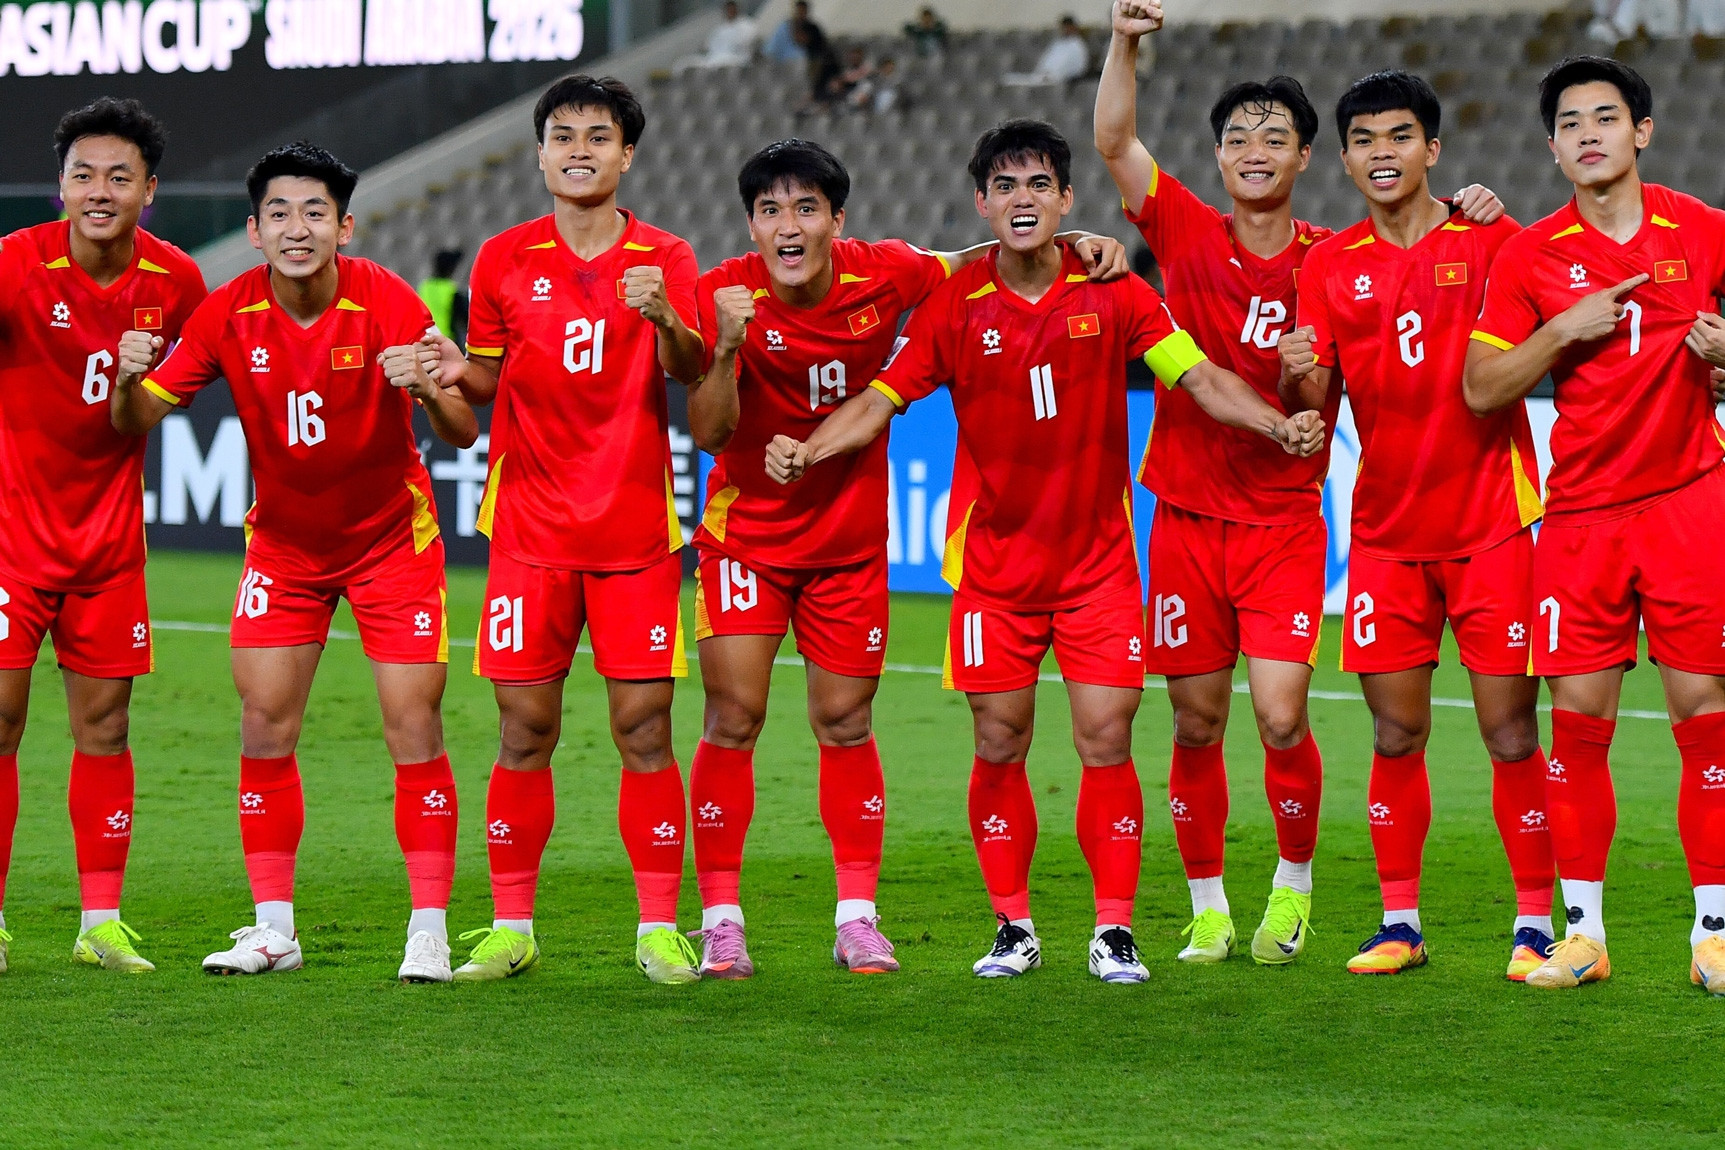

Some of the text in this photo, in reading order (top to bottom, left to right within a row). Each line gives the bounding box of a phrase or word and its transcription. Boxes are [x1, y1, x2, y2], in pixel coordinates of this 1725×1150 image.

[0, 1, 143, 76] ASIAN
[142, 0, 252, 73] CUP
[562, 317, 606, 375] 21
[1240, 295, 1287, 349] 12
[1396, 309, 1425, 368] 2
[1618, 299, 1643, 357] 7
[81, 348, 114, 405] 6
[808, 359, 846, 412] 19
[1029, 363, 1058, 421] 11
[287, 389, 326, 447] 16
[235, 567, 274, 619] 16
[719, 557, 758, 613] 19
[488, 594, 524, 653] 21
[963, 611, 984, 668] 11
[1154, 593, 1188, 649] 12
[1353, 591, 1376, 648] 2
[1539, 595, 1561, 653] 7
